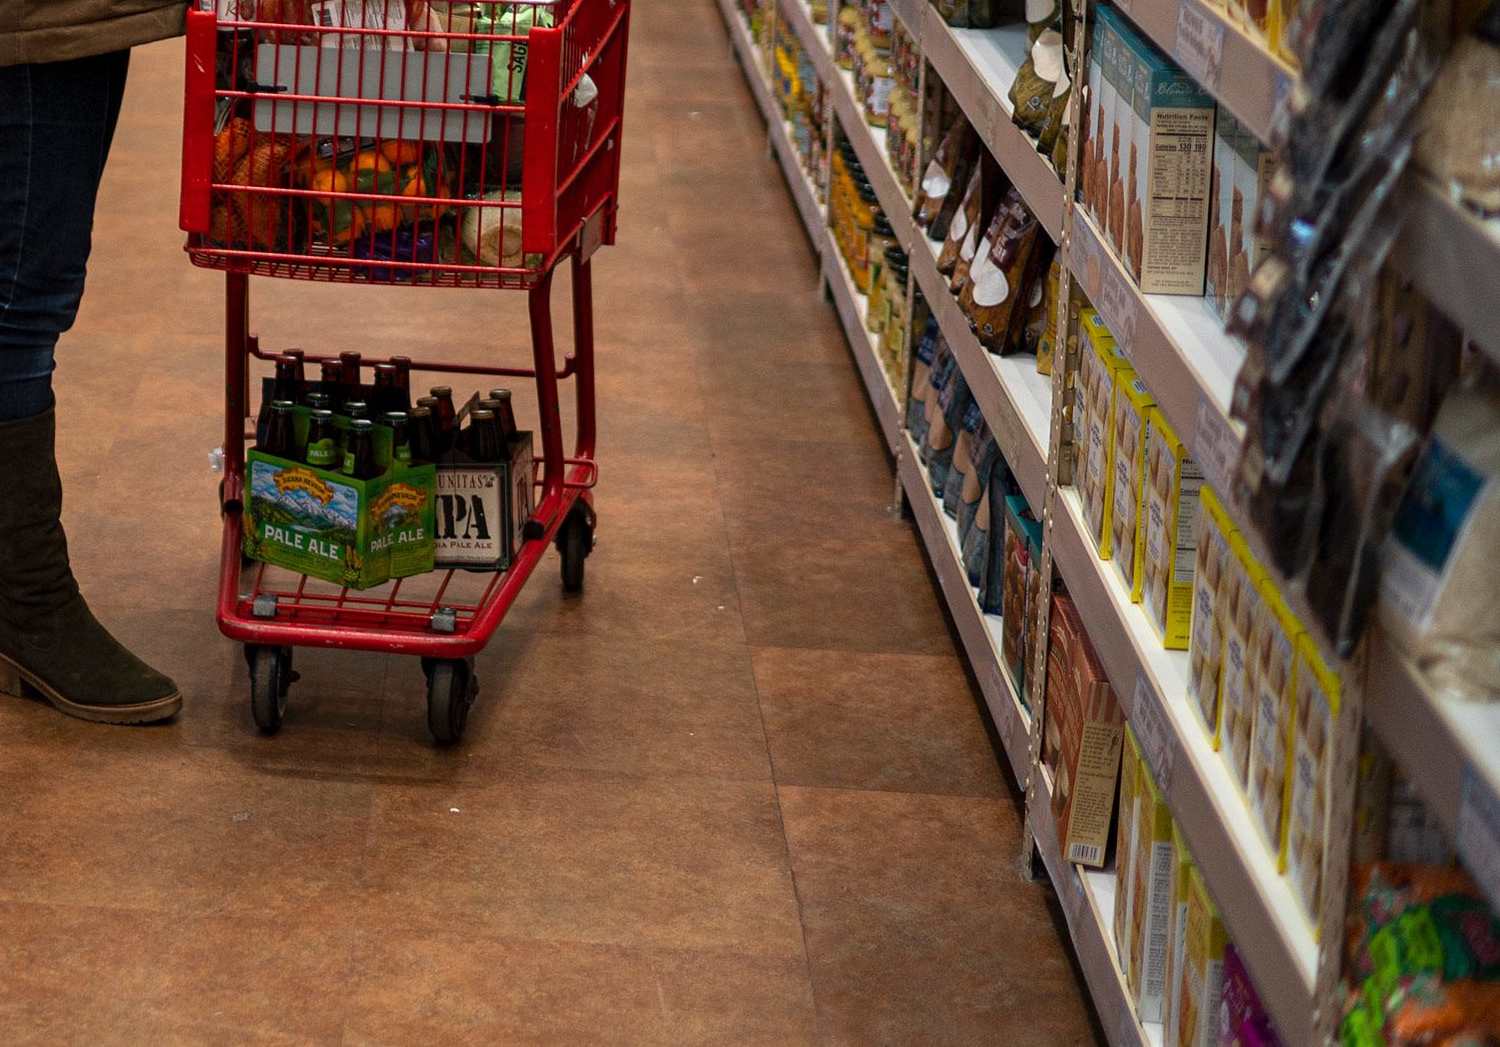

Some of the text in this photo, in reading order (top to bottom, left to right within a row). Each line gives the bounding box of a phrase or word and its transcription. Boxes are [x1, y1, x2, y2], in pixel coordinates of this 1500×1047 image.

[1157, 112, 1209, 122] Nutrition Facts
[310, 450, 329, 458] PALE
[282, 475, 326, 494] SIERRA NEVADA
[438, 473, 484, 489] UNITAS
[435, 494, 491, 540] IPA
[265, 525, 303, 549] PALE
[308, 537, 338, 560] ALE
[371, 528, 424, 553] PALE ALE
[450, 541, 470, 550] PALE
[474, 542, 492, 550] ALE
